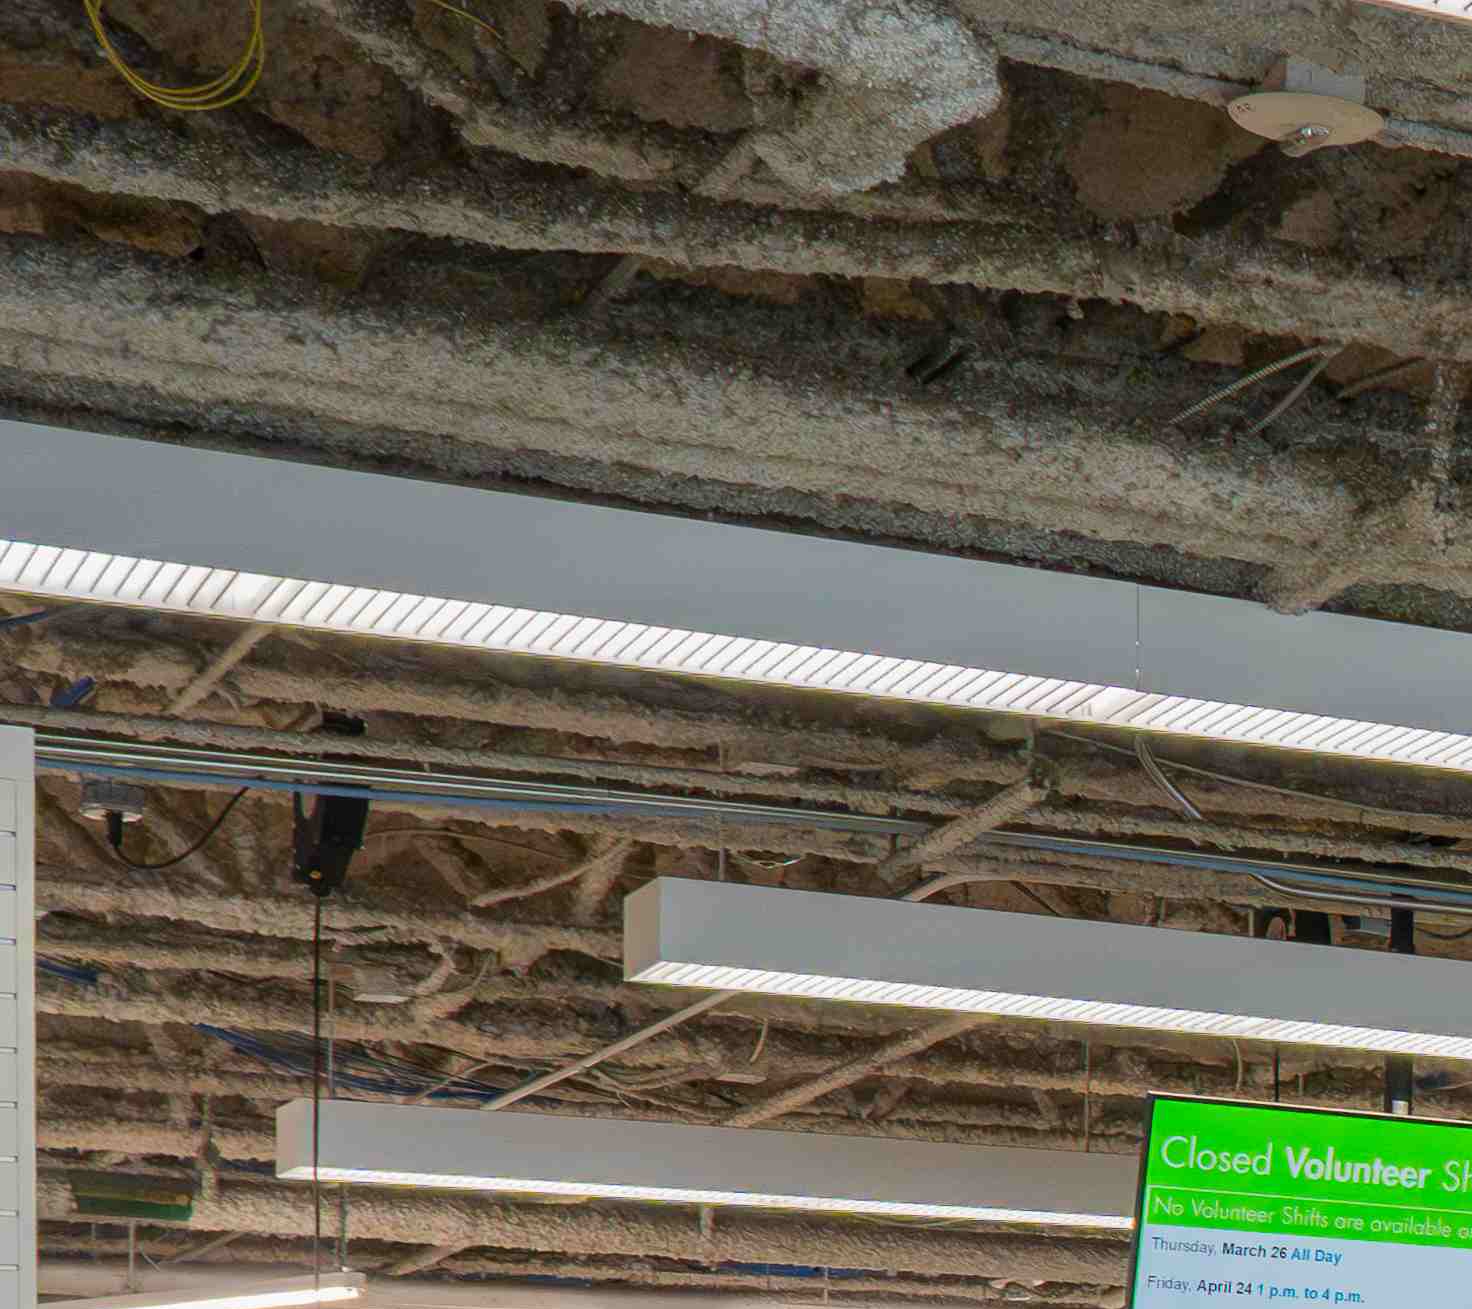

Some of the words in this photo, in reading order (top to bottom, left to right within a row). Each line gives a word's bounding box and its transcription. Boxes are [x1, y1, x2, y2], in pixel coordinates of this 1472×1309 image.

[1160, 1135, 1274, 1176] Closed
[1286, 1146, 1432, 1189] Volunteer
[1152, 1196, 1184, 1217] No
[1191, 1198, 1274, 1225] Volunteer
[1281, 1205, 1329, 1229] Shifts
[1335, 1214, 1364, 1230] are
[1370, 1214, 1452, 1239] available
[1152, 1236, 1217, 1257] Thursday,
[1222, 1242, 1267, 1259] March
[1270, 1246, 1288, 1260] 26
[1290, 1248, 1310, 1262] All
[1314, 1249, 1343, 1266] Day
[1147, 1275, 1192, 1293] Friday,
[1196, 1279, 1232, 1296] April
[1236, 1282, 1252, 1295] 24
[1256, 1283, 1264, 1296] 1
[1268, 1286, 1299, 1300] p.m.
[1304, 1287, 1319, 1300] to
[1321, 1288, 1330, 1301] 4
[1334, 1290, 1365, 1305] p.m.
